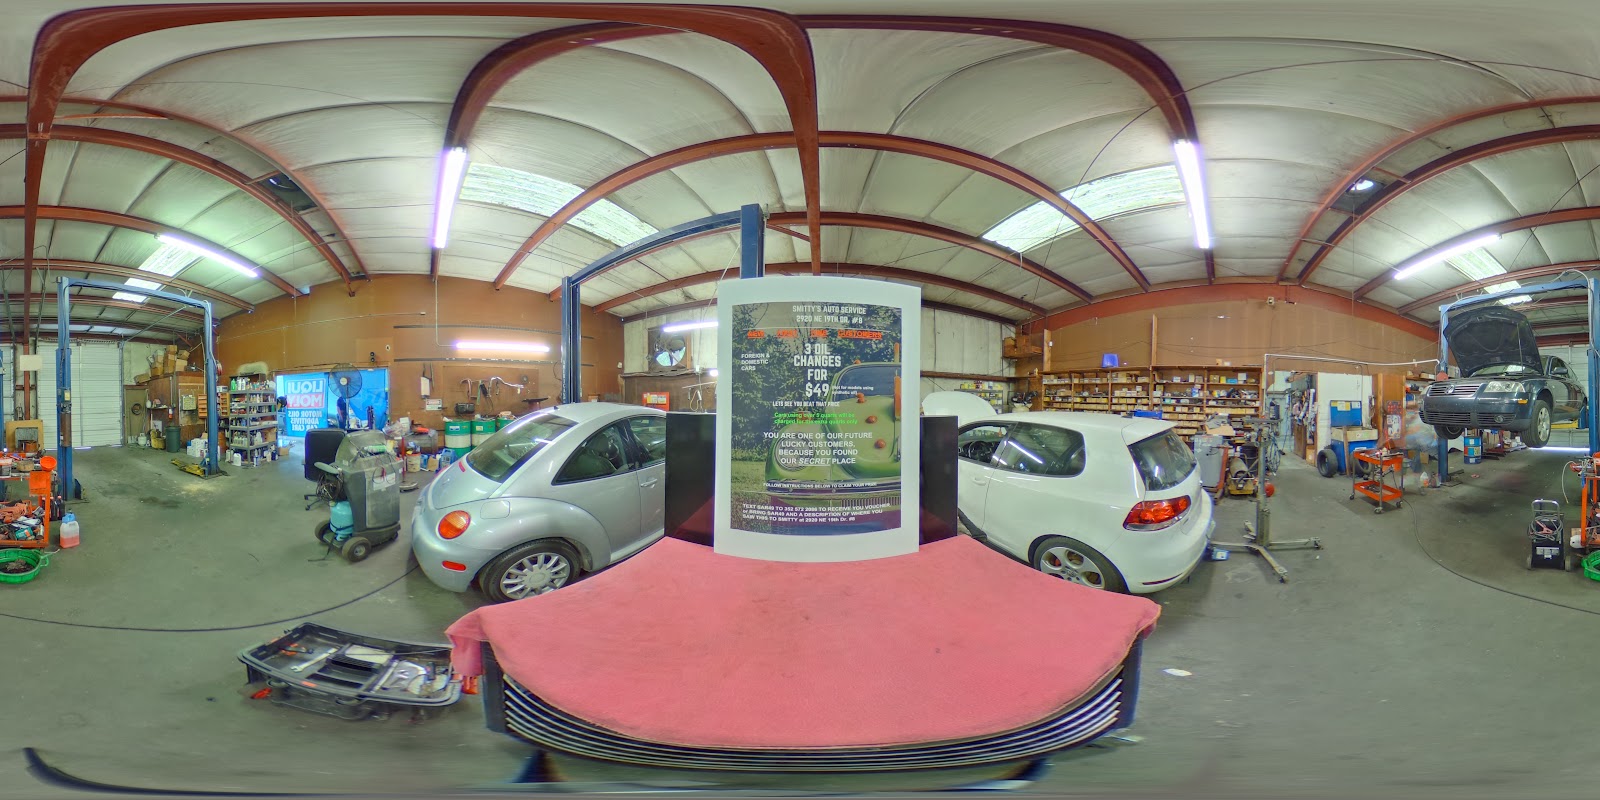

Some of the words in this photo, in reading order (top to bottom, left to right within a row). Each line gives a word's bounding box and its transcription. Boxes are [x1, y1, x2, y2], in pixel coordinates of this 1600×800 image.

[838, 330, 882, 339] CUSTOMERS
[805, 344, 811, 354] 3
[815, 344, 830, 355] OIL
[794, 355, 841, 367] CHANGES
[808, 369, 828, 380] FOR
[805, 382, 829, 397] $49
